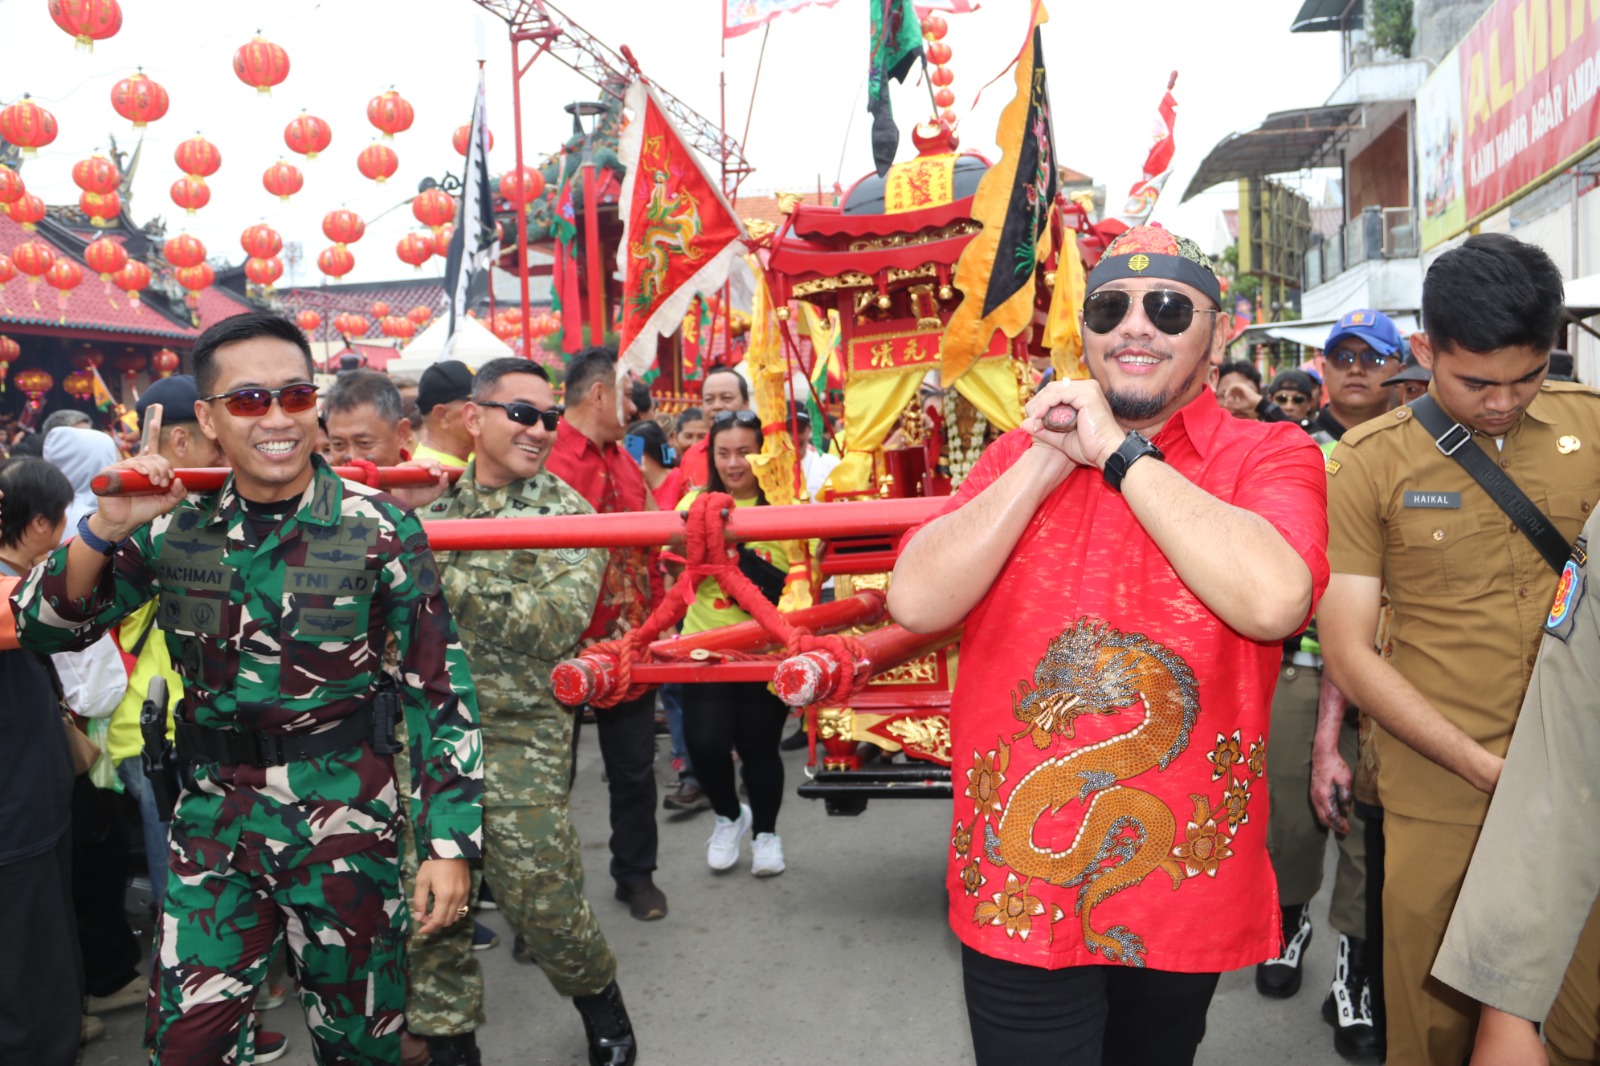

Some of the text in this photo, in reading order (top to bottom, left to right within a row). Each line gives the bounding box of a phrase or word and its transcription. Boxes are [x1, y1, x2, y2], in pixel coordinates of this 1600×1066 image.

[1470, 138, 1495, 188] KAMI
[1531, 83, 1564, 144] AGAR
[1413, 494, 1449, 504] HAIKAL
[293, 571, 367, 591] TNI AD
